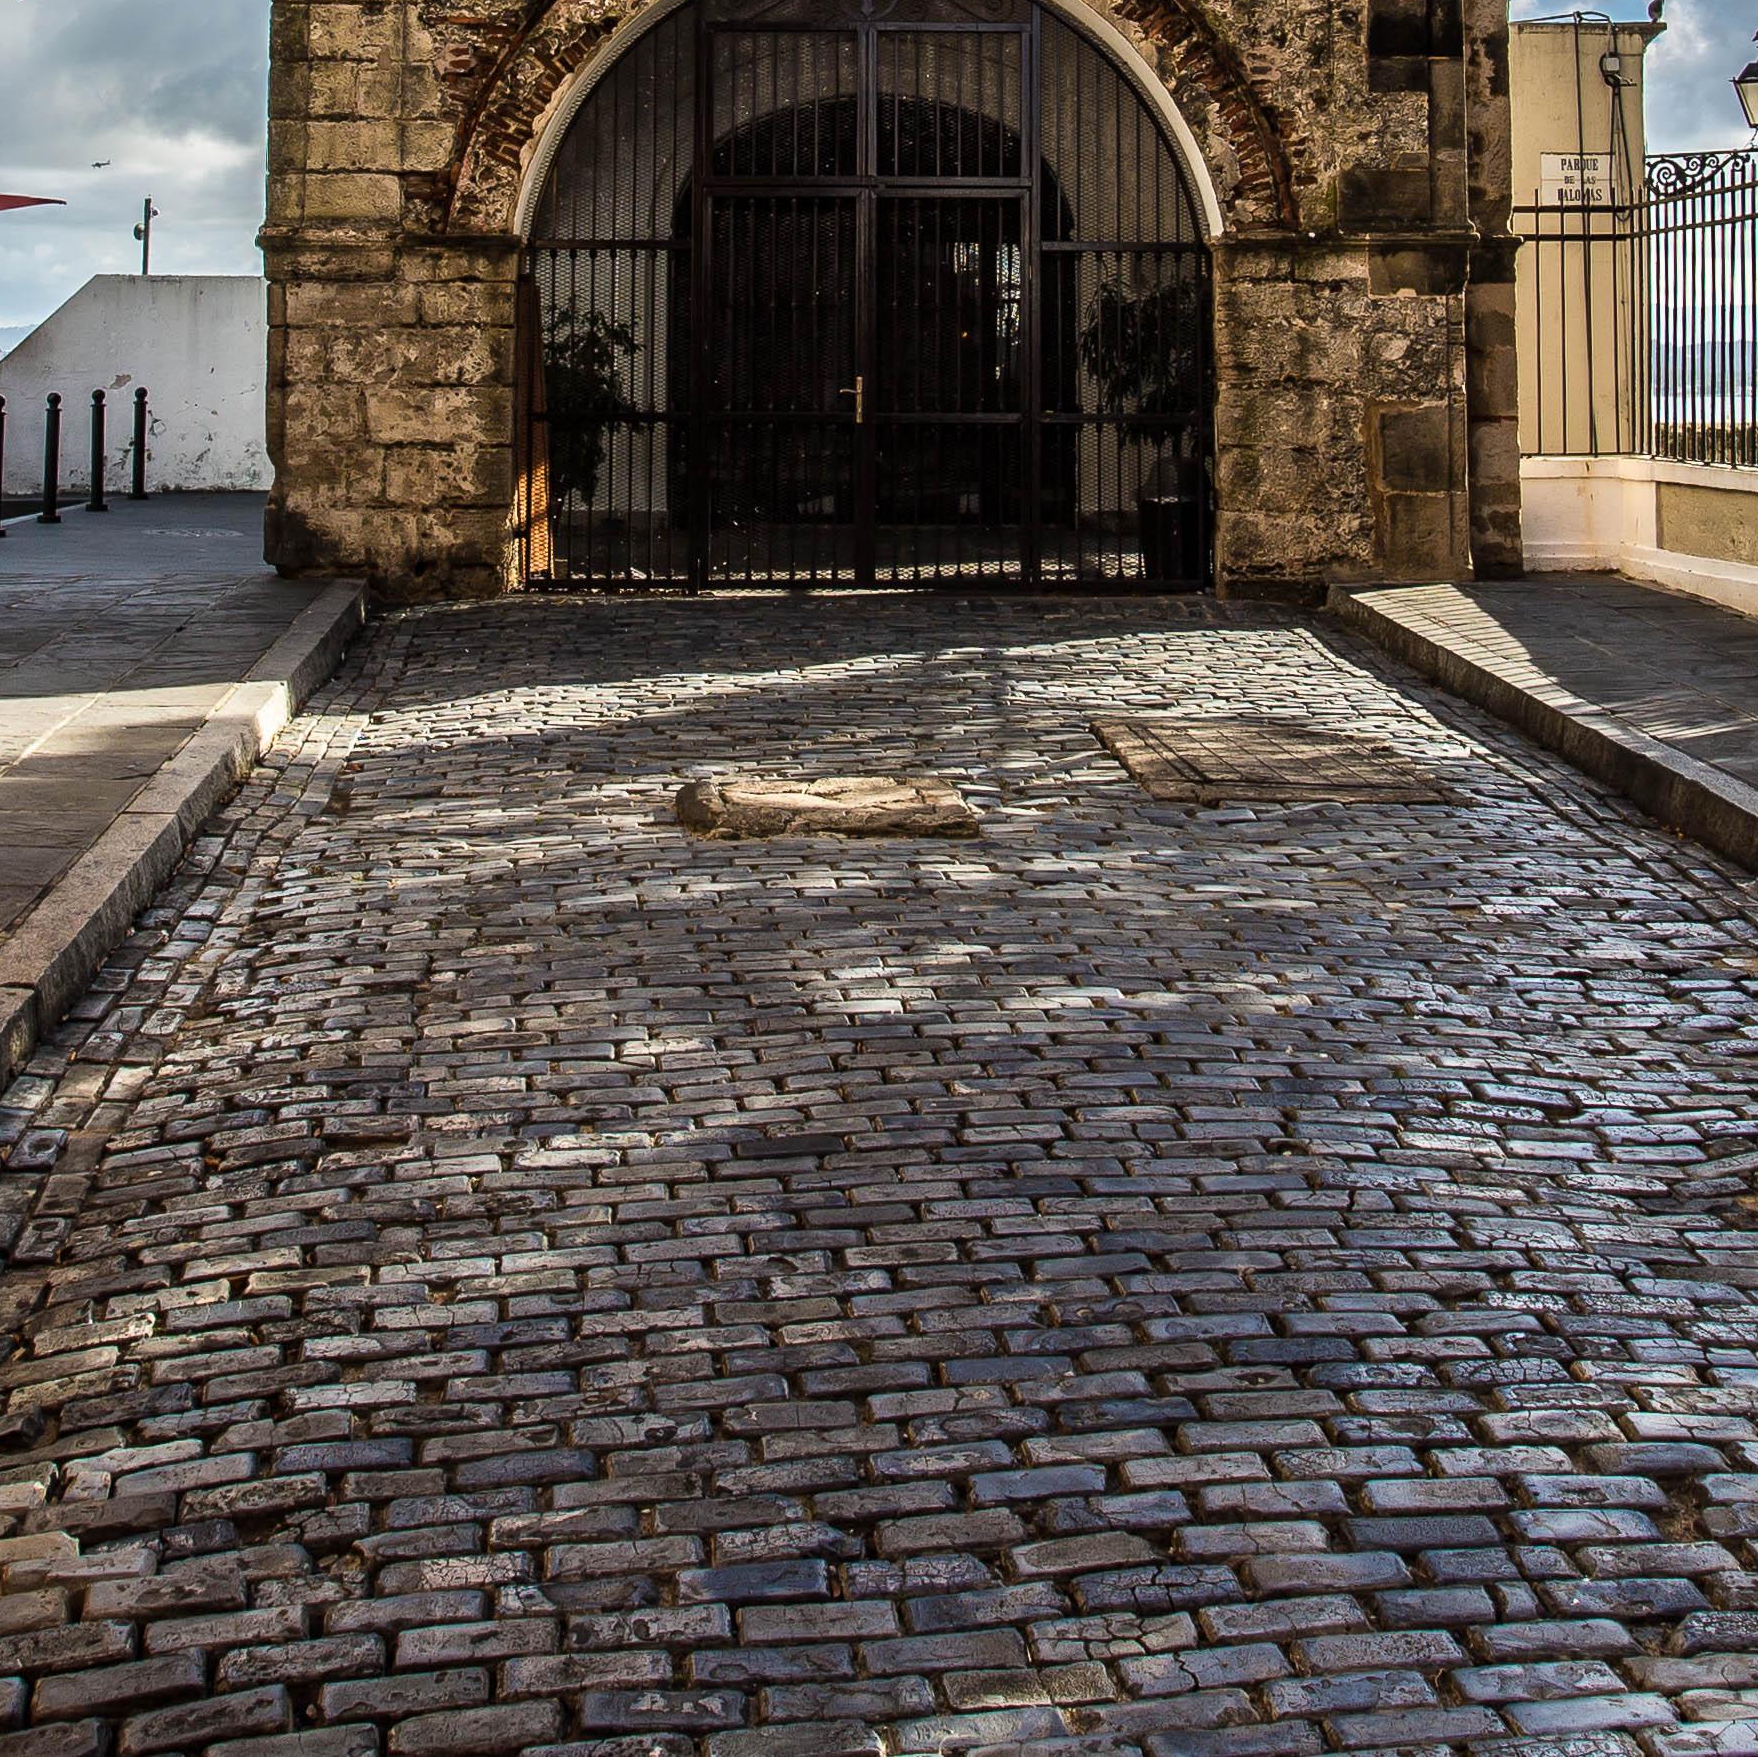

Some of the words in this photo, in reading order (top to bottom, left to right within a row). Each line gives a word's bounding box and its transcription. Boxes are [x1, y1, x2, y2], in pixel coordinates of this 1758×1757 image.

[1561, 158, 1598, 171] PARQUE
[1564, 176, 1575, 184] DE
[1558, 188, 1602, 202] ALOAS
